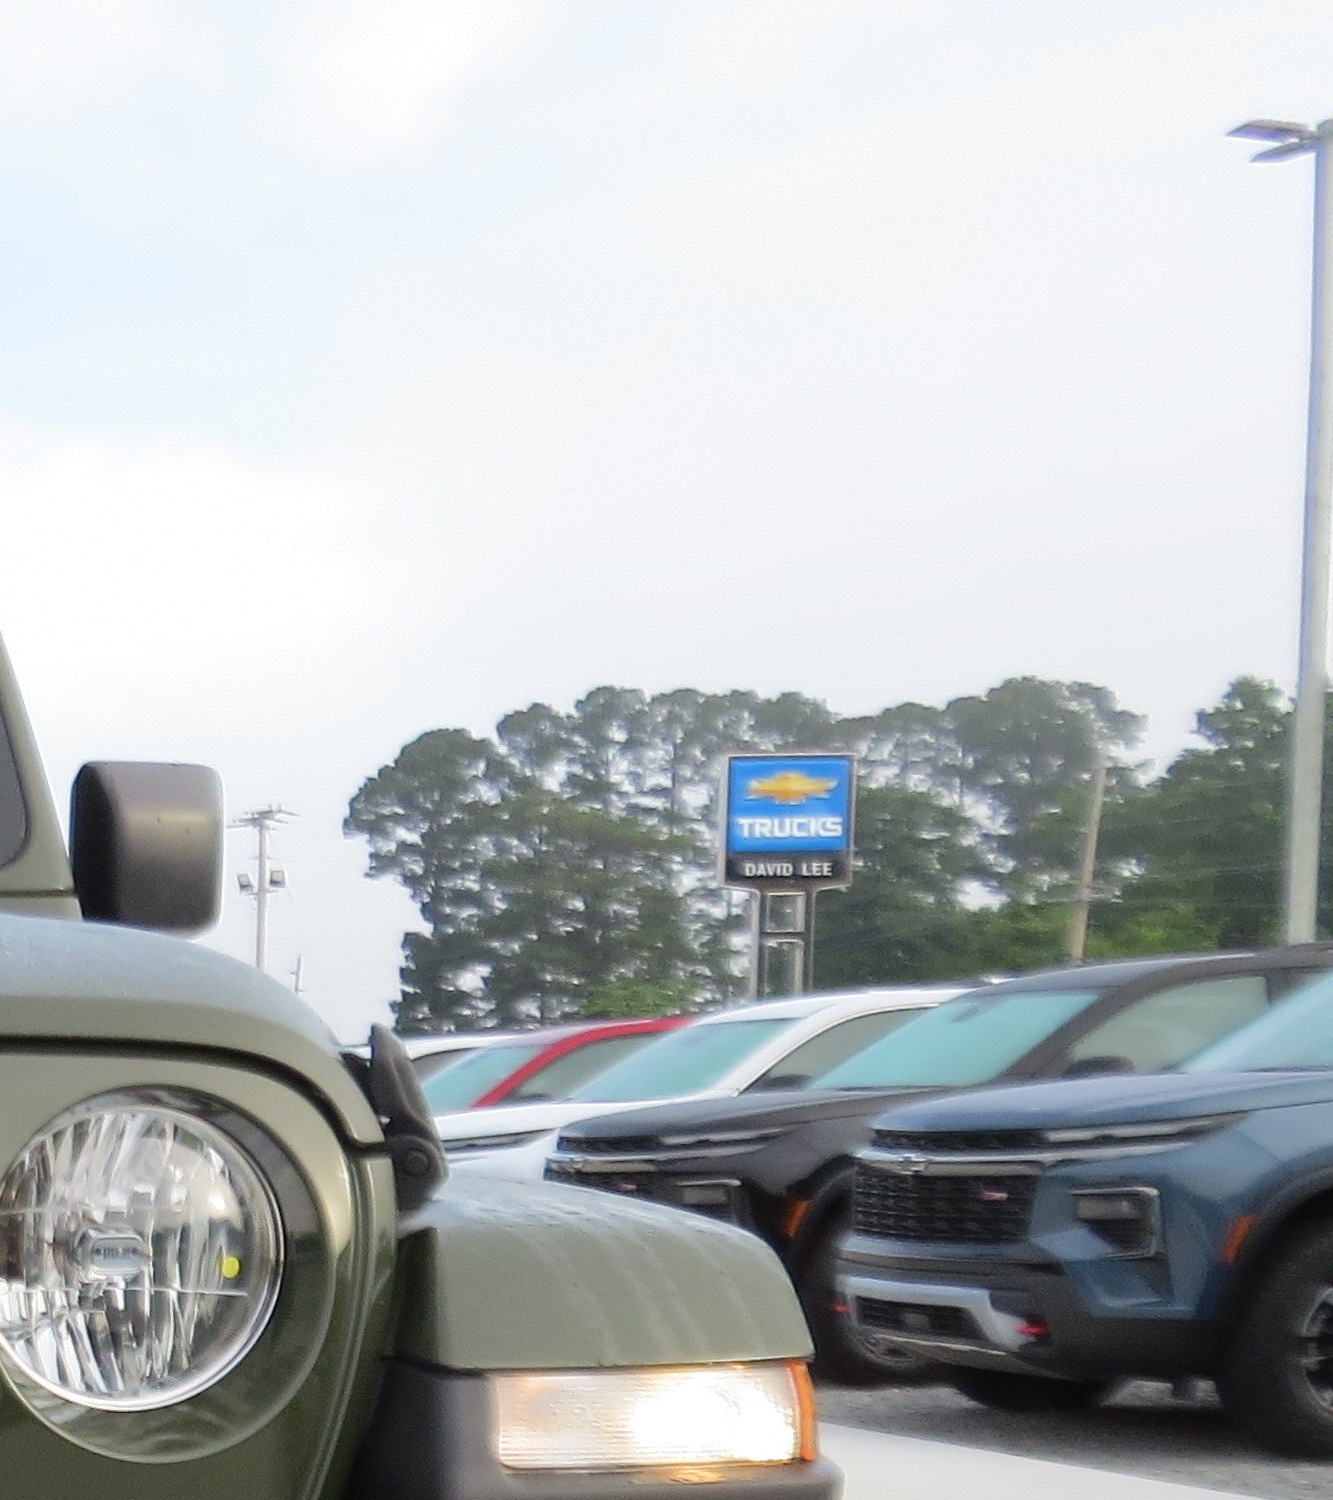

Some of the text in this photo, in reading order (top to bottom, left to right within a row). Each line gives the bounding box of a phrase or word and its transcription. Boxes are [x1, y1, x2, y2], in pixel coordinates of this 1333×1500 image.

[737, 816, 842, 838] TRUCKS
[745, 862, 833, 877] DAVID LEE
